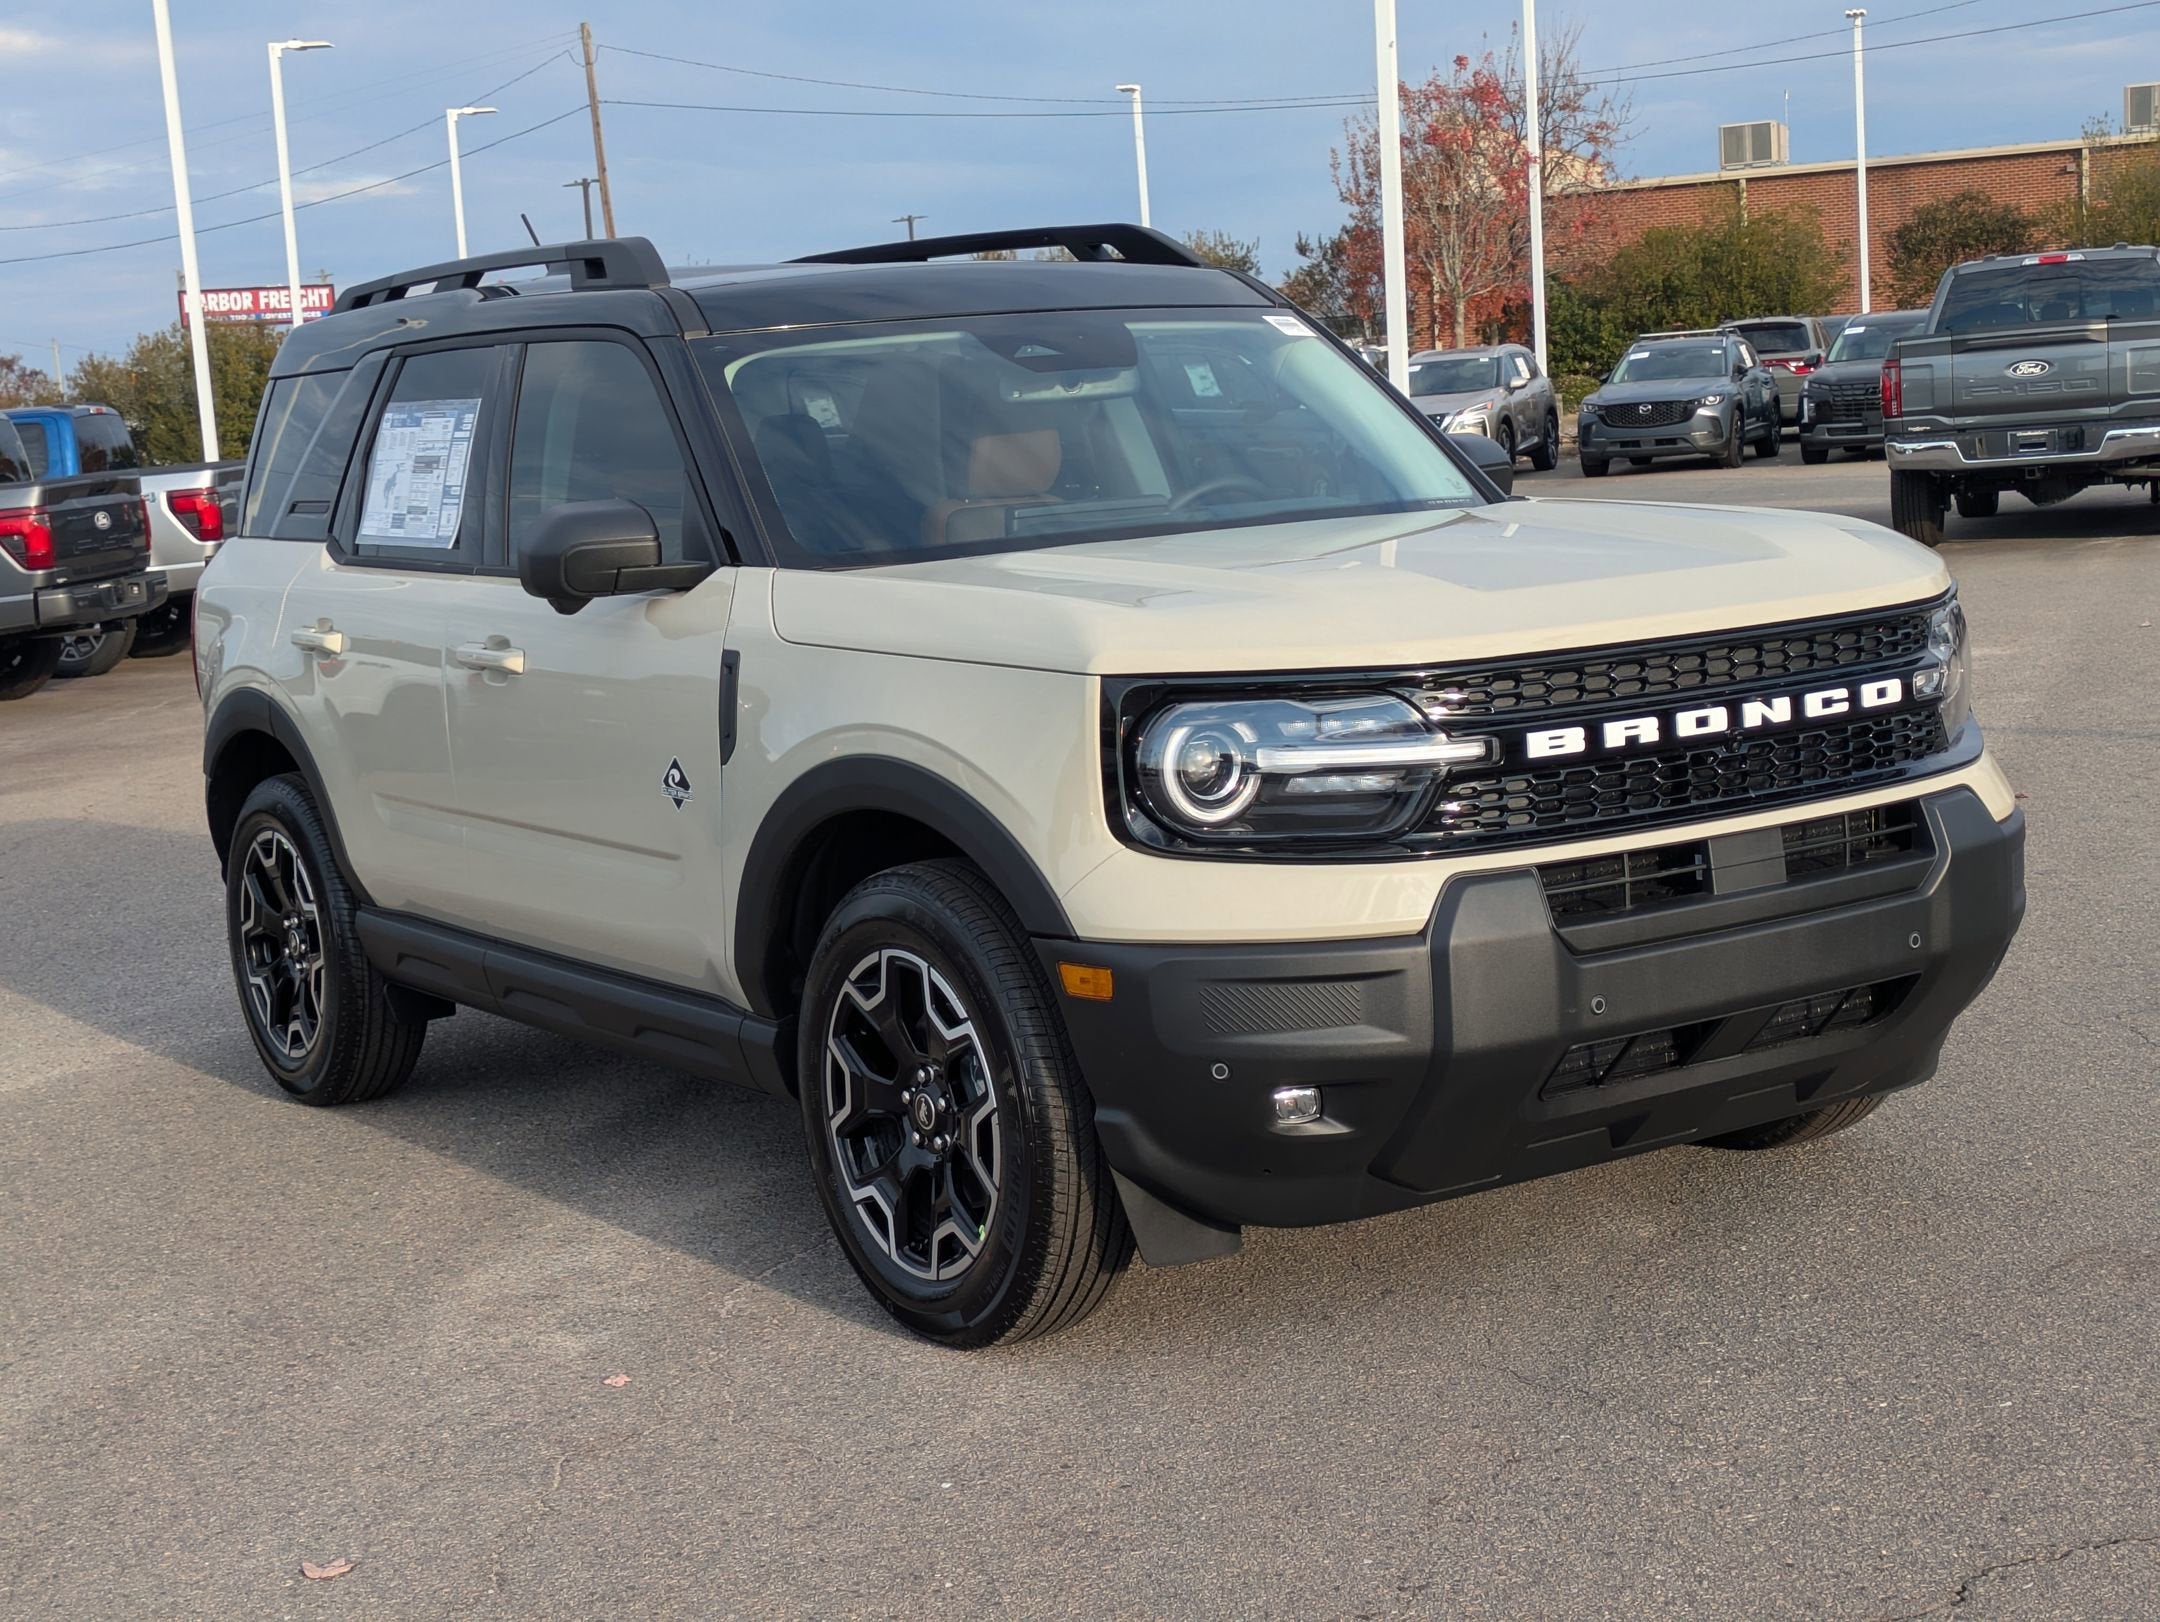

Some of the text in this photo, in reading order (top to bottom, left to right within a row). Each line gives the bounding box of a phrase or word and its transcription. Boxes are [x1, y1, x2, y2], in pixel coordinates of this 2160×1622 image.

[258, 287, 330, 310] FREGHT
[2016, 363, 2041, 374] Ford
[1961, 378, 2098, 400] F-150
[1525, 678, 1903, 759] BRONCO
